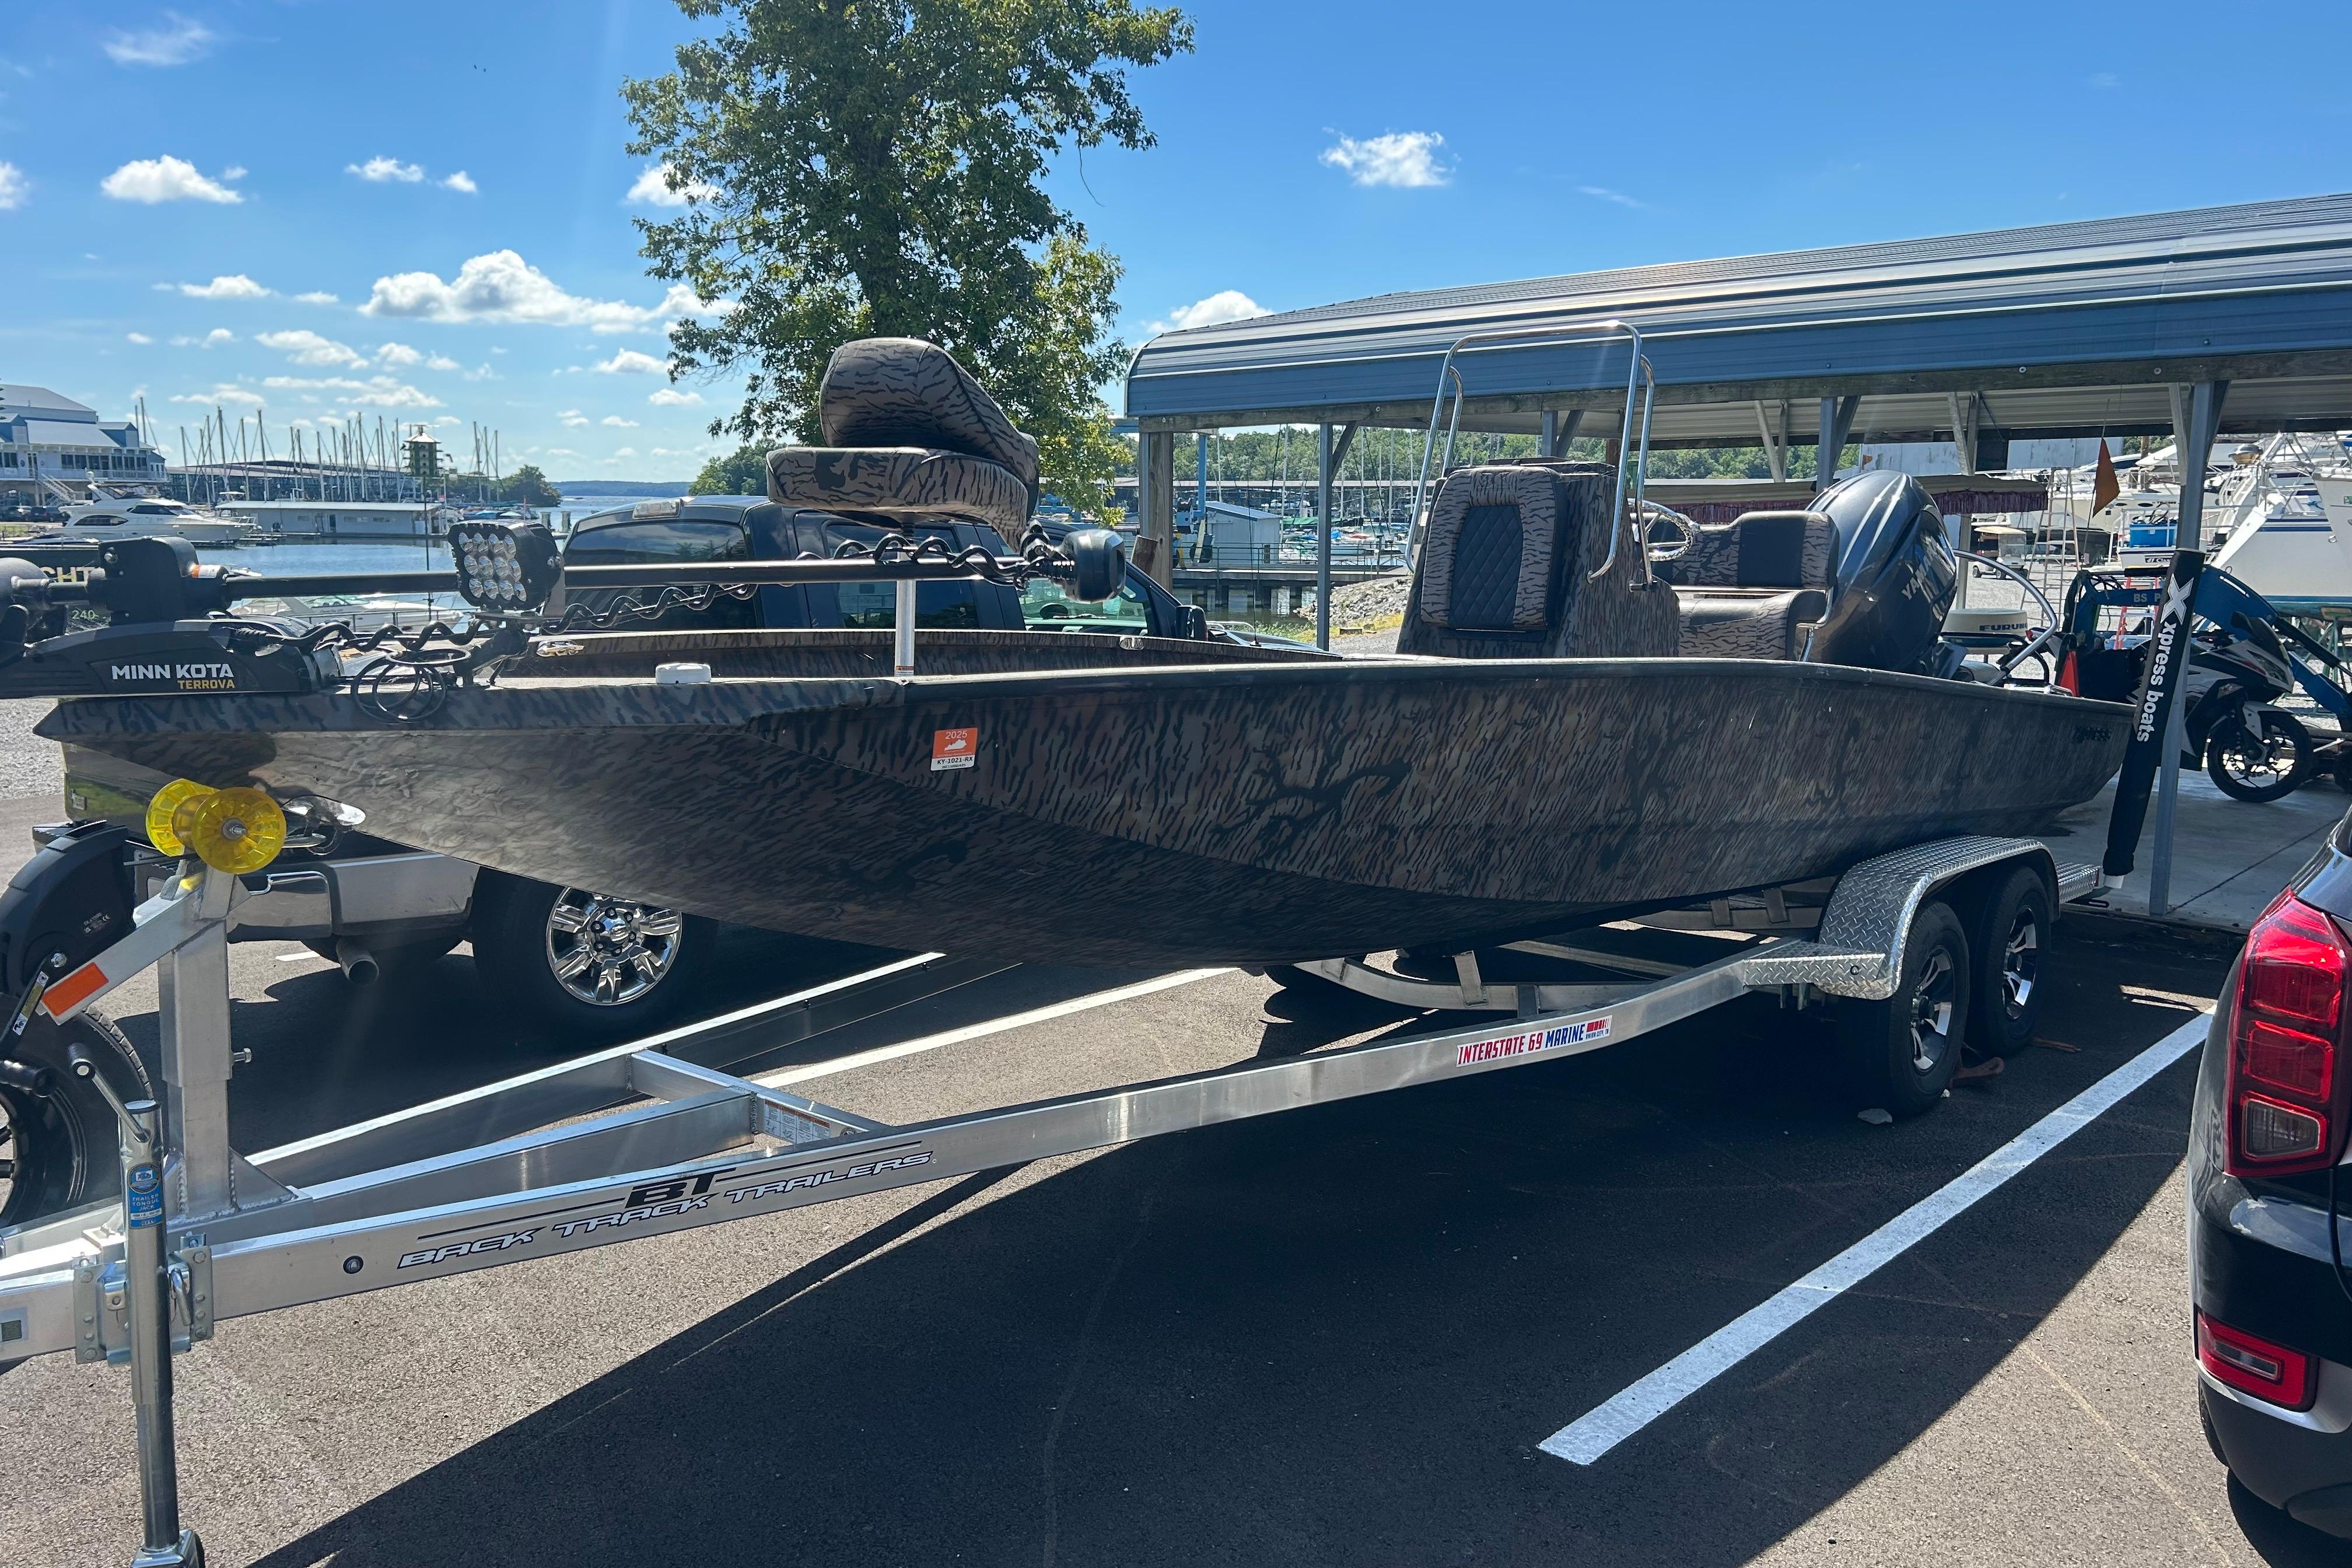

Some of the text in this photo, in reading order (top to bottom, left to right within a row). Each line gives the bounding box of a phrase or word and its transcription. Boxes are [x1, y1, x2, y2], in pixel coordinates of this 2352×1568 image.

[2133, 593, 2147, 603] BS
[111, 663, 235, 680] MINN KOTA
[2151, 621, 2177, 686] xpress
[177, 679, 235, 690] TERROVA
[945, 730, 968, 740] 2025
[2137, 690, 2164, 743] boats
[1458, 1023, 1586, 1065] INTERSTATE 69 MARINE
[625, 1167, 736, 1209] BT
[397, 1150, 934, 1269] BACK TRACK TRAILERS
